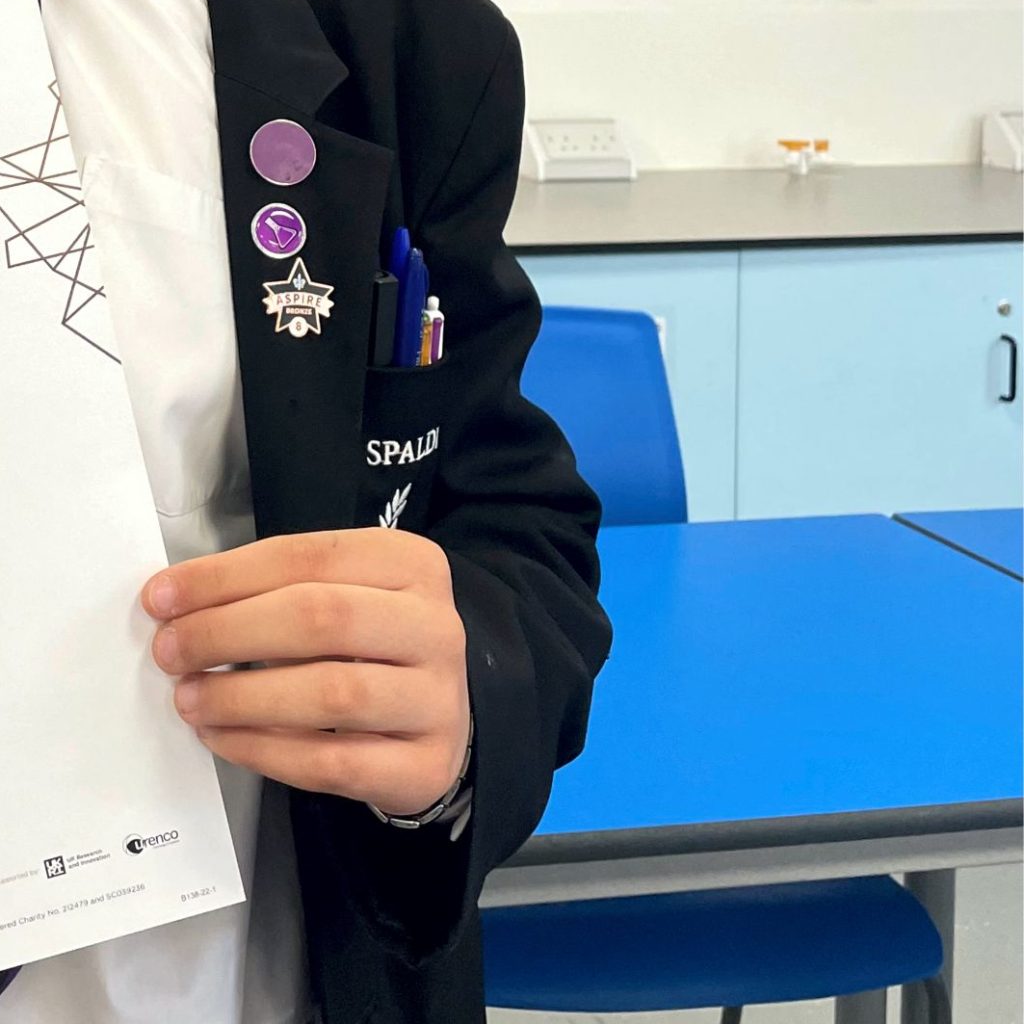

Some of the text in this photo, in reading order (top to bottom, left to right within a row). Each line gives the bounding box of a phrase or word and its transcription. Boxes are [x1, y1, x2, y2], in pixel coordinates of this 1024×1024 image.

[276, 293, 322, 308] ASPIRE
[18, 912, 46, 926] Charity
[47, 907, 60, 917] No.
[90, 894, 105, 905] and
